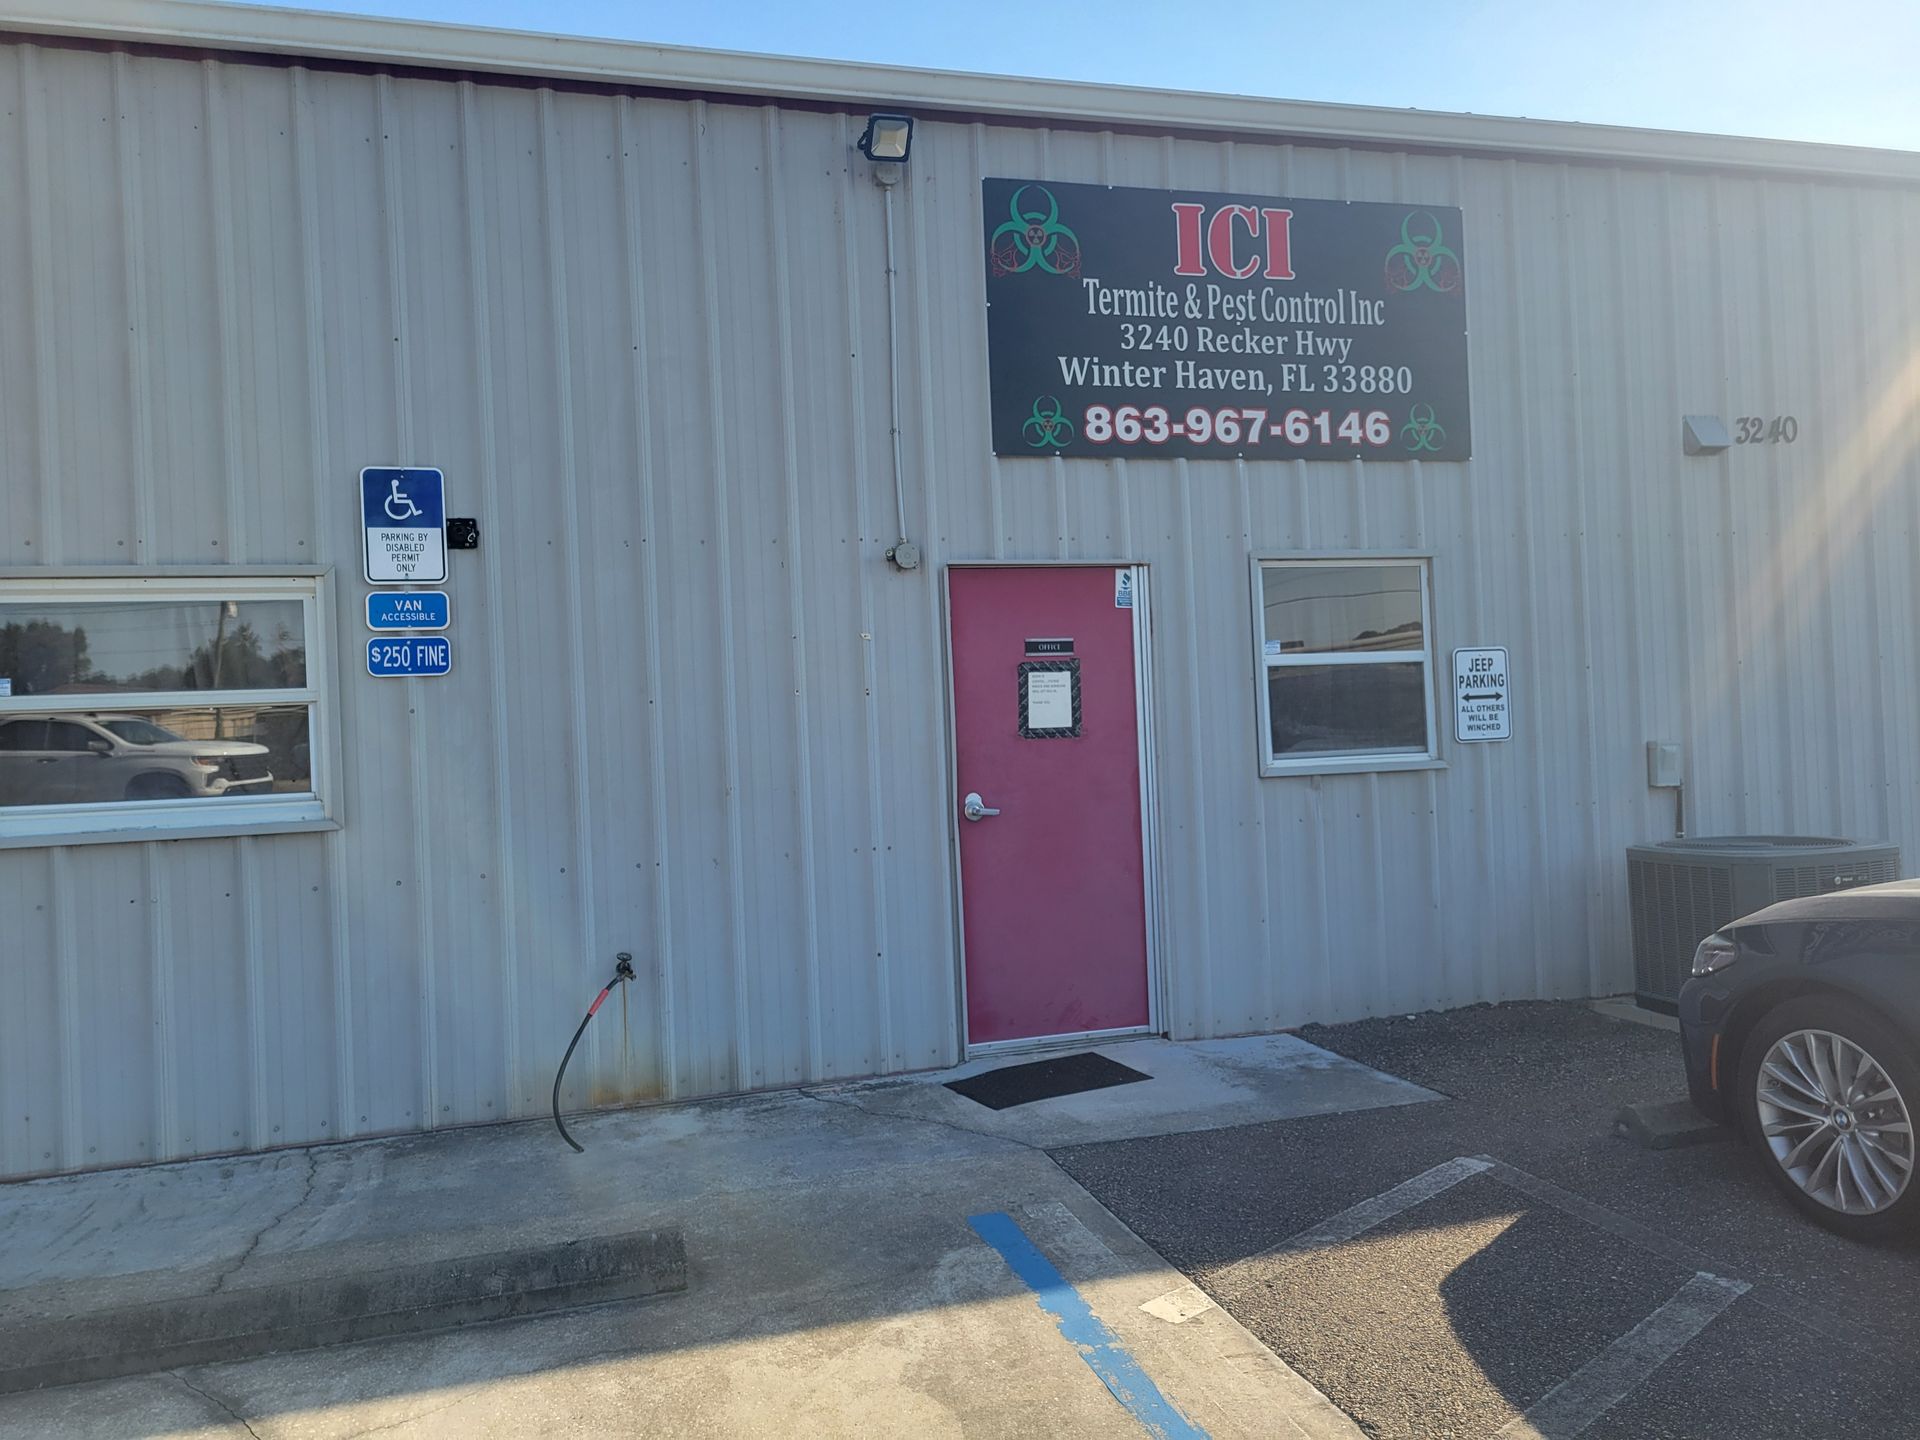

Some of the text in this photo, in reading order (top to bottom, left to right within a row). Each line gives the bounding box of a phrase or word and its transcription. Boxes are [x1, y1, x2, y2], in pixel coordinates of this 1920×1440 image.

[1172, 203, 1295, 281] ICI
[1083, 278, 1385, 326] Termite & Pest Control Inc
[1120, 323, 1352, 364] 3240 Recker Hwy
[1058, 356, 1412, 396] Winter Haven, FL 33880
[1085, 404, 1391, 446] 863-967-6146
[1735, 416, 1798, 445] 3240
[381, 532, 428, 542] PARKING BY
[386, 543, 425, 552] DISABLED
[391, 553, 420, 562] PERMIT
[396, 563, 416, 573] ONLY
[395, 600, 422, 611] VAN
[381, 612, 436, 621] ACCESSIBLE
[1038, 643, 1061, 651] OFFICE
[371, 645, 447, 667] $250 FINE
[1468, 658, 1493, 673] JEEP
[1459, 674, 1505, 689] PARKING
[1461, 704, 1505, 713] ALL OTHERS
[1468, 713, 1499, 722] WILL BE
[1467, 723, 1501, 732] WINCHED
